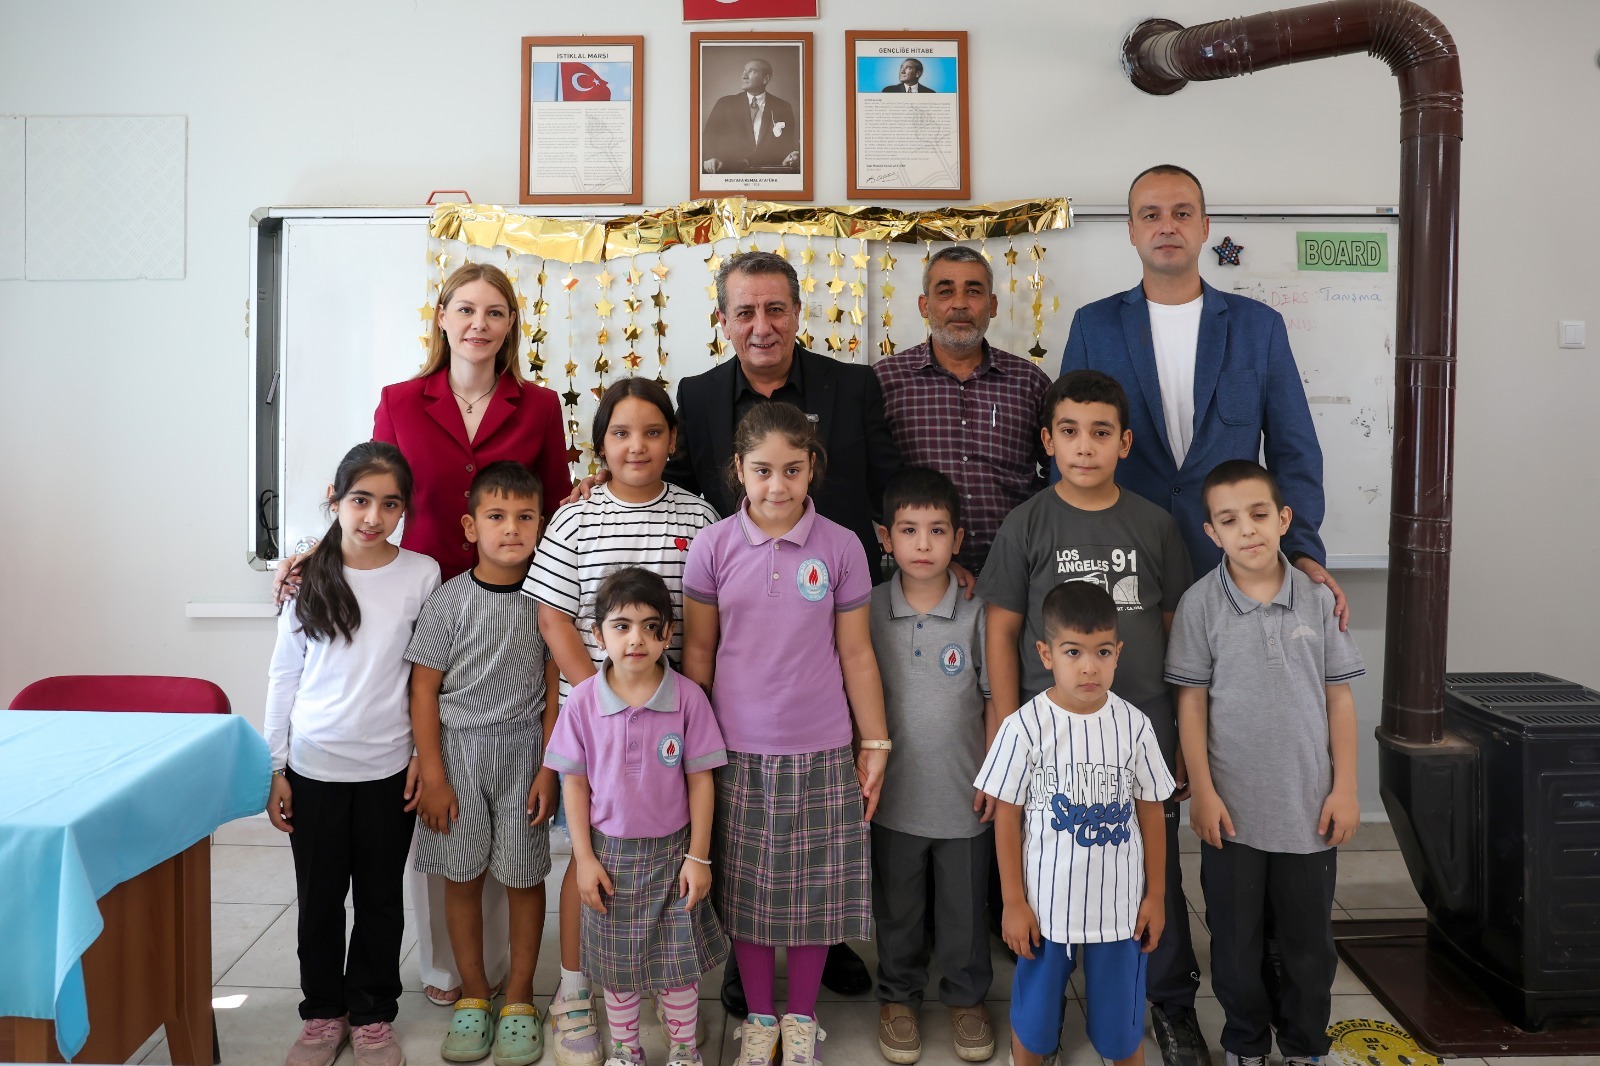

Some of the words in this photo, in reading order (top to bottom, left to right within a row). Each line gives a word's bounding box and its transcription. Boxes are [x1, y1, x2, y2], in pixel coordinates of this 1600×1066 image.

[911, 46, 934, 54] HİTABE
[1305, 239, 1382, 266] BOARD
[1056, 549, 1080, 562] LOS
[1111, 548, 1137, 573] 91
[1057, 559, 1110, 574] ANGELES
[1375, 1023, 1413, 1040] KORU
